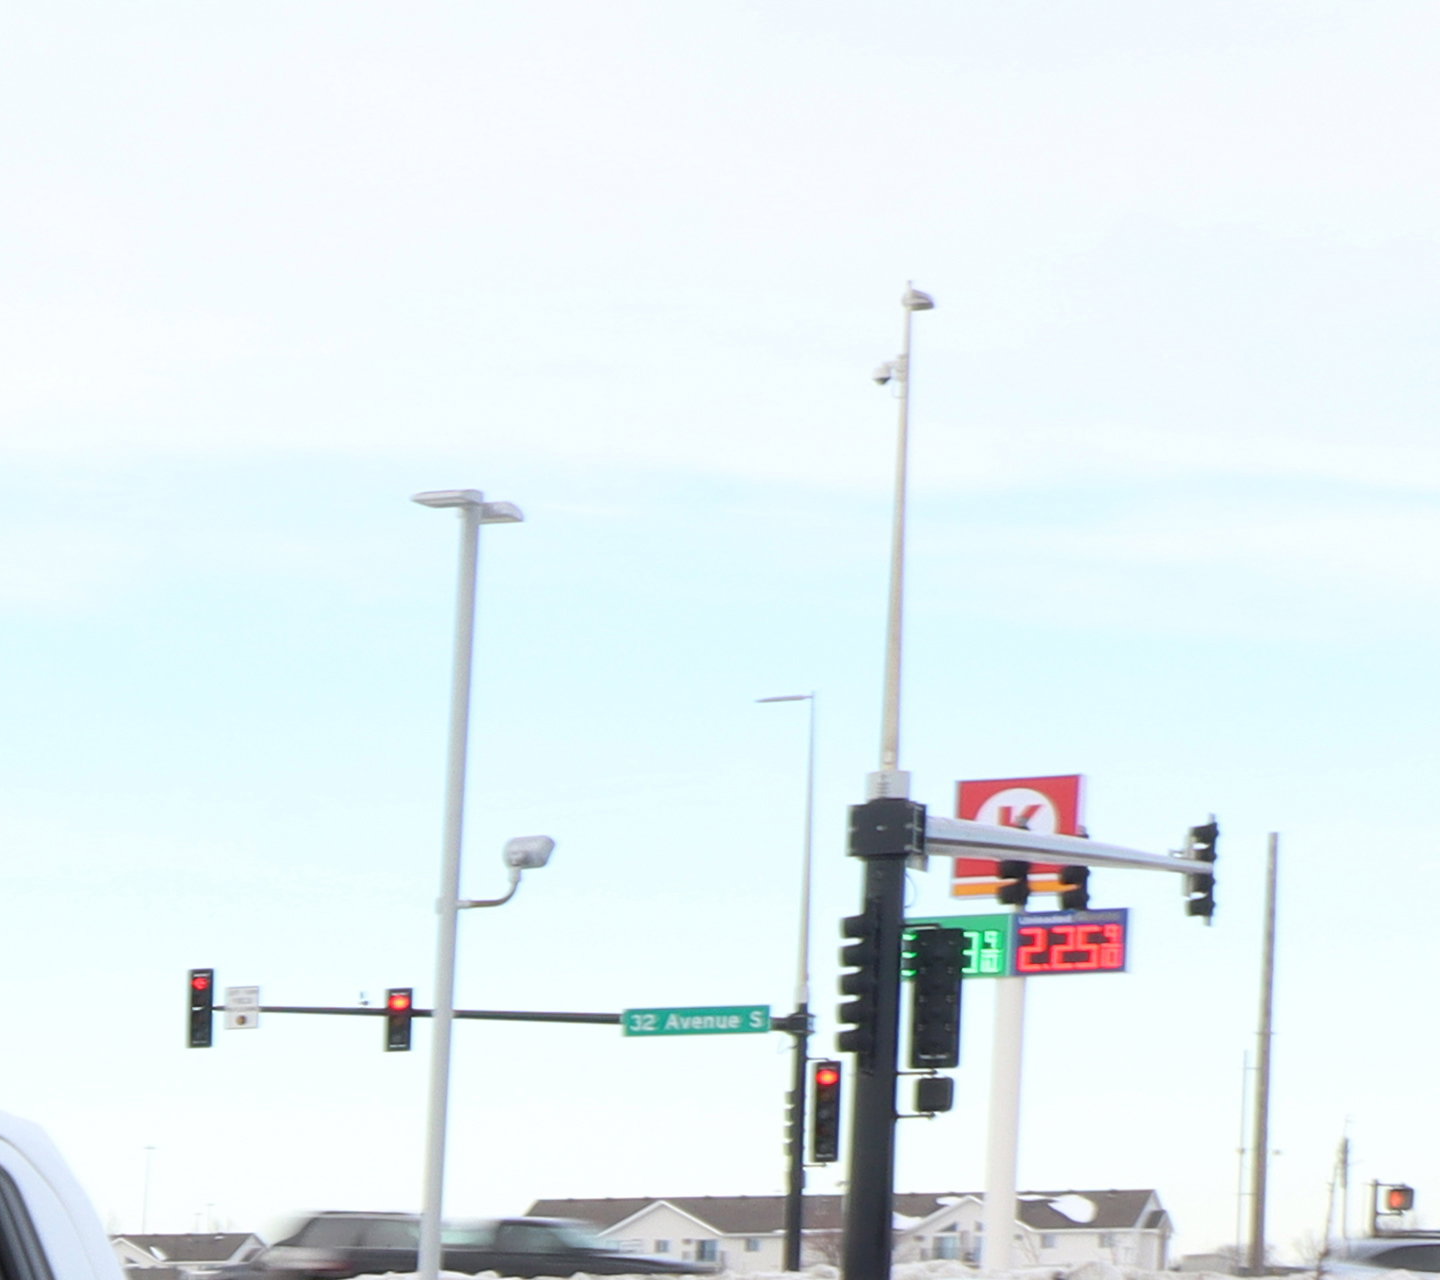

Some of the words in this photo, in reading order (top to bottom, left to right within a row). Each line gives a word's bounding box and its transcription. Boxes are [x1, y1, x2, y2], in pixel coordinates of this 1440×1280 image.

[630, 1014, 657, 1031] 32
[664, 1013, 741, 1030] Avenue
[749, 1011, 763, 1028] S
